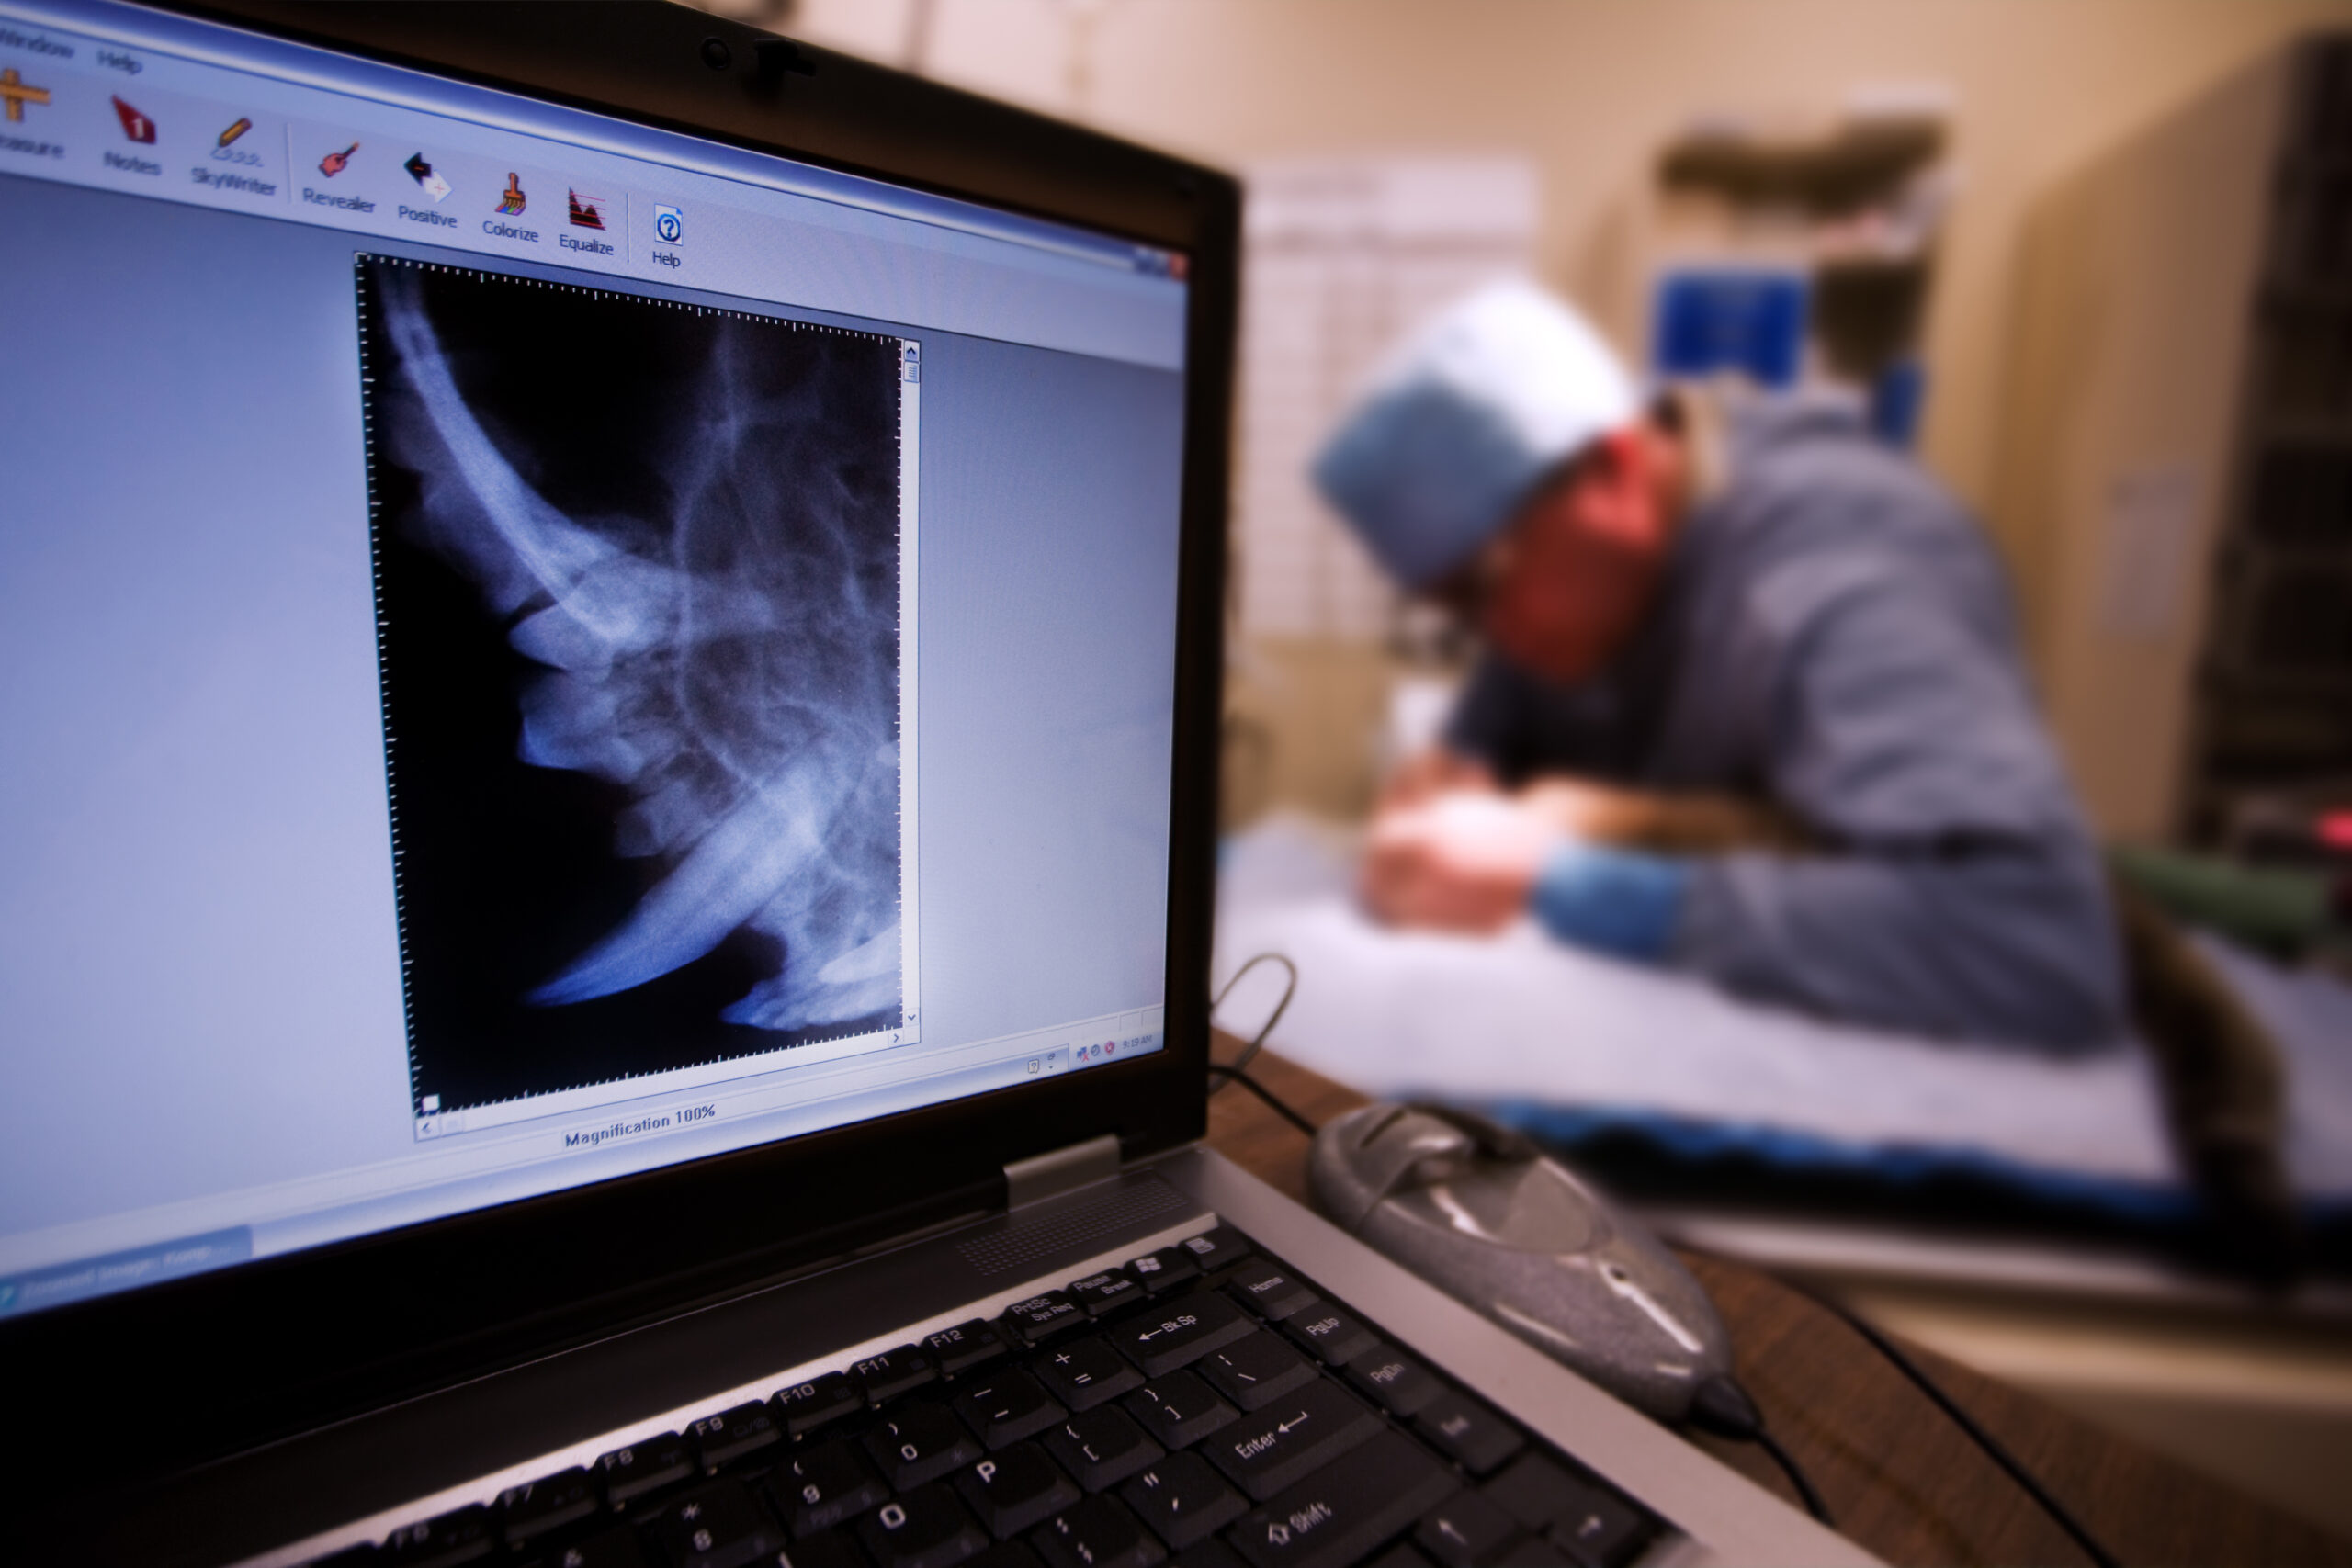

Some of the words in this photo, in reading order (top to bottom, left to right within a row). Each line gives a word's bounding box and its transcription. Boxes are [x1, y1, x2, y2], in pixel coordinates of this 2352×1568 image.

[96, 50, 143, 75] Help
[104, 151, 163, 176] Notes
[190, 167, 277, 196] SkyWriter
[302, 187, 377, 214] Revealer
[397, 204, 458, 229] Positive
[481, 220, 540, 243] Colorize
[559, 233, 615, 256] Equalize
[651, 250, 682, 269] Help
[564, 1116, 671, 1148] Magnification
[675, 1103, 716, 1125] 100%
[1072, 1274, 1112, 1292] Pause
[1100, 1279, 1134, 1296] Break
[1249, 1276, 1284, 1293] Home
[1012, 1296, 1052, 1315] PrtSc
[1030, 1308, 1053, 1323] Sys
[1050, 1303, 1076, 1315] Req
[1159, 1320, 1182, 1333] Bk
[1176, 1314, 1198, 1326] Sp
[1306, 1316, 1340, 1336] PgUp
[930, 1329, 964, 1348] F12
[856, 1356, 889, 1375] F11
[1369, 1362, 1405, 1383] PgDn
[779, 1383, 816, 1404] F10
[1234, 1430, 1277, 1460] Enter
[603, 1448, 634, 1472] F8
[976, 1459, 997, 1484] P
[879, 1502, 907, 1530] O
[1289, 1500, 1333, 1534] Shift
